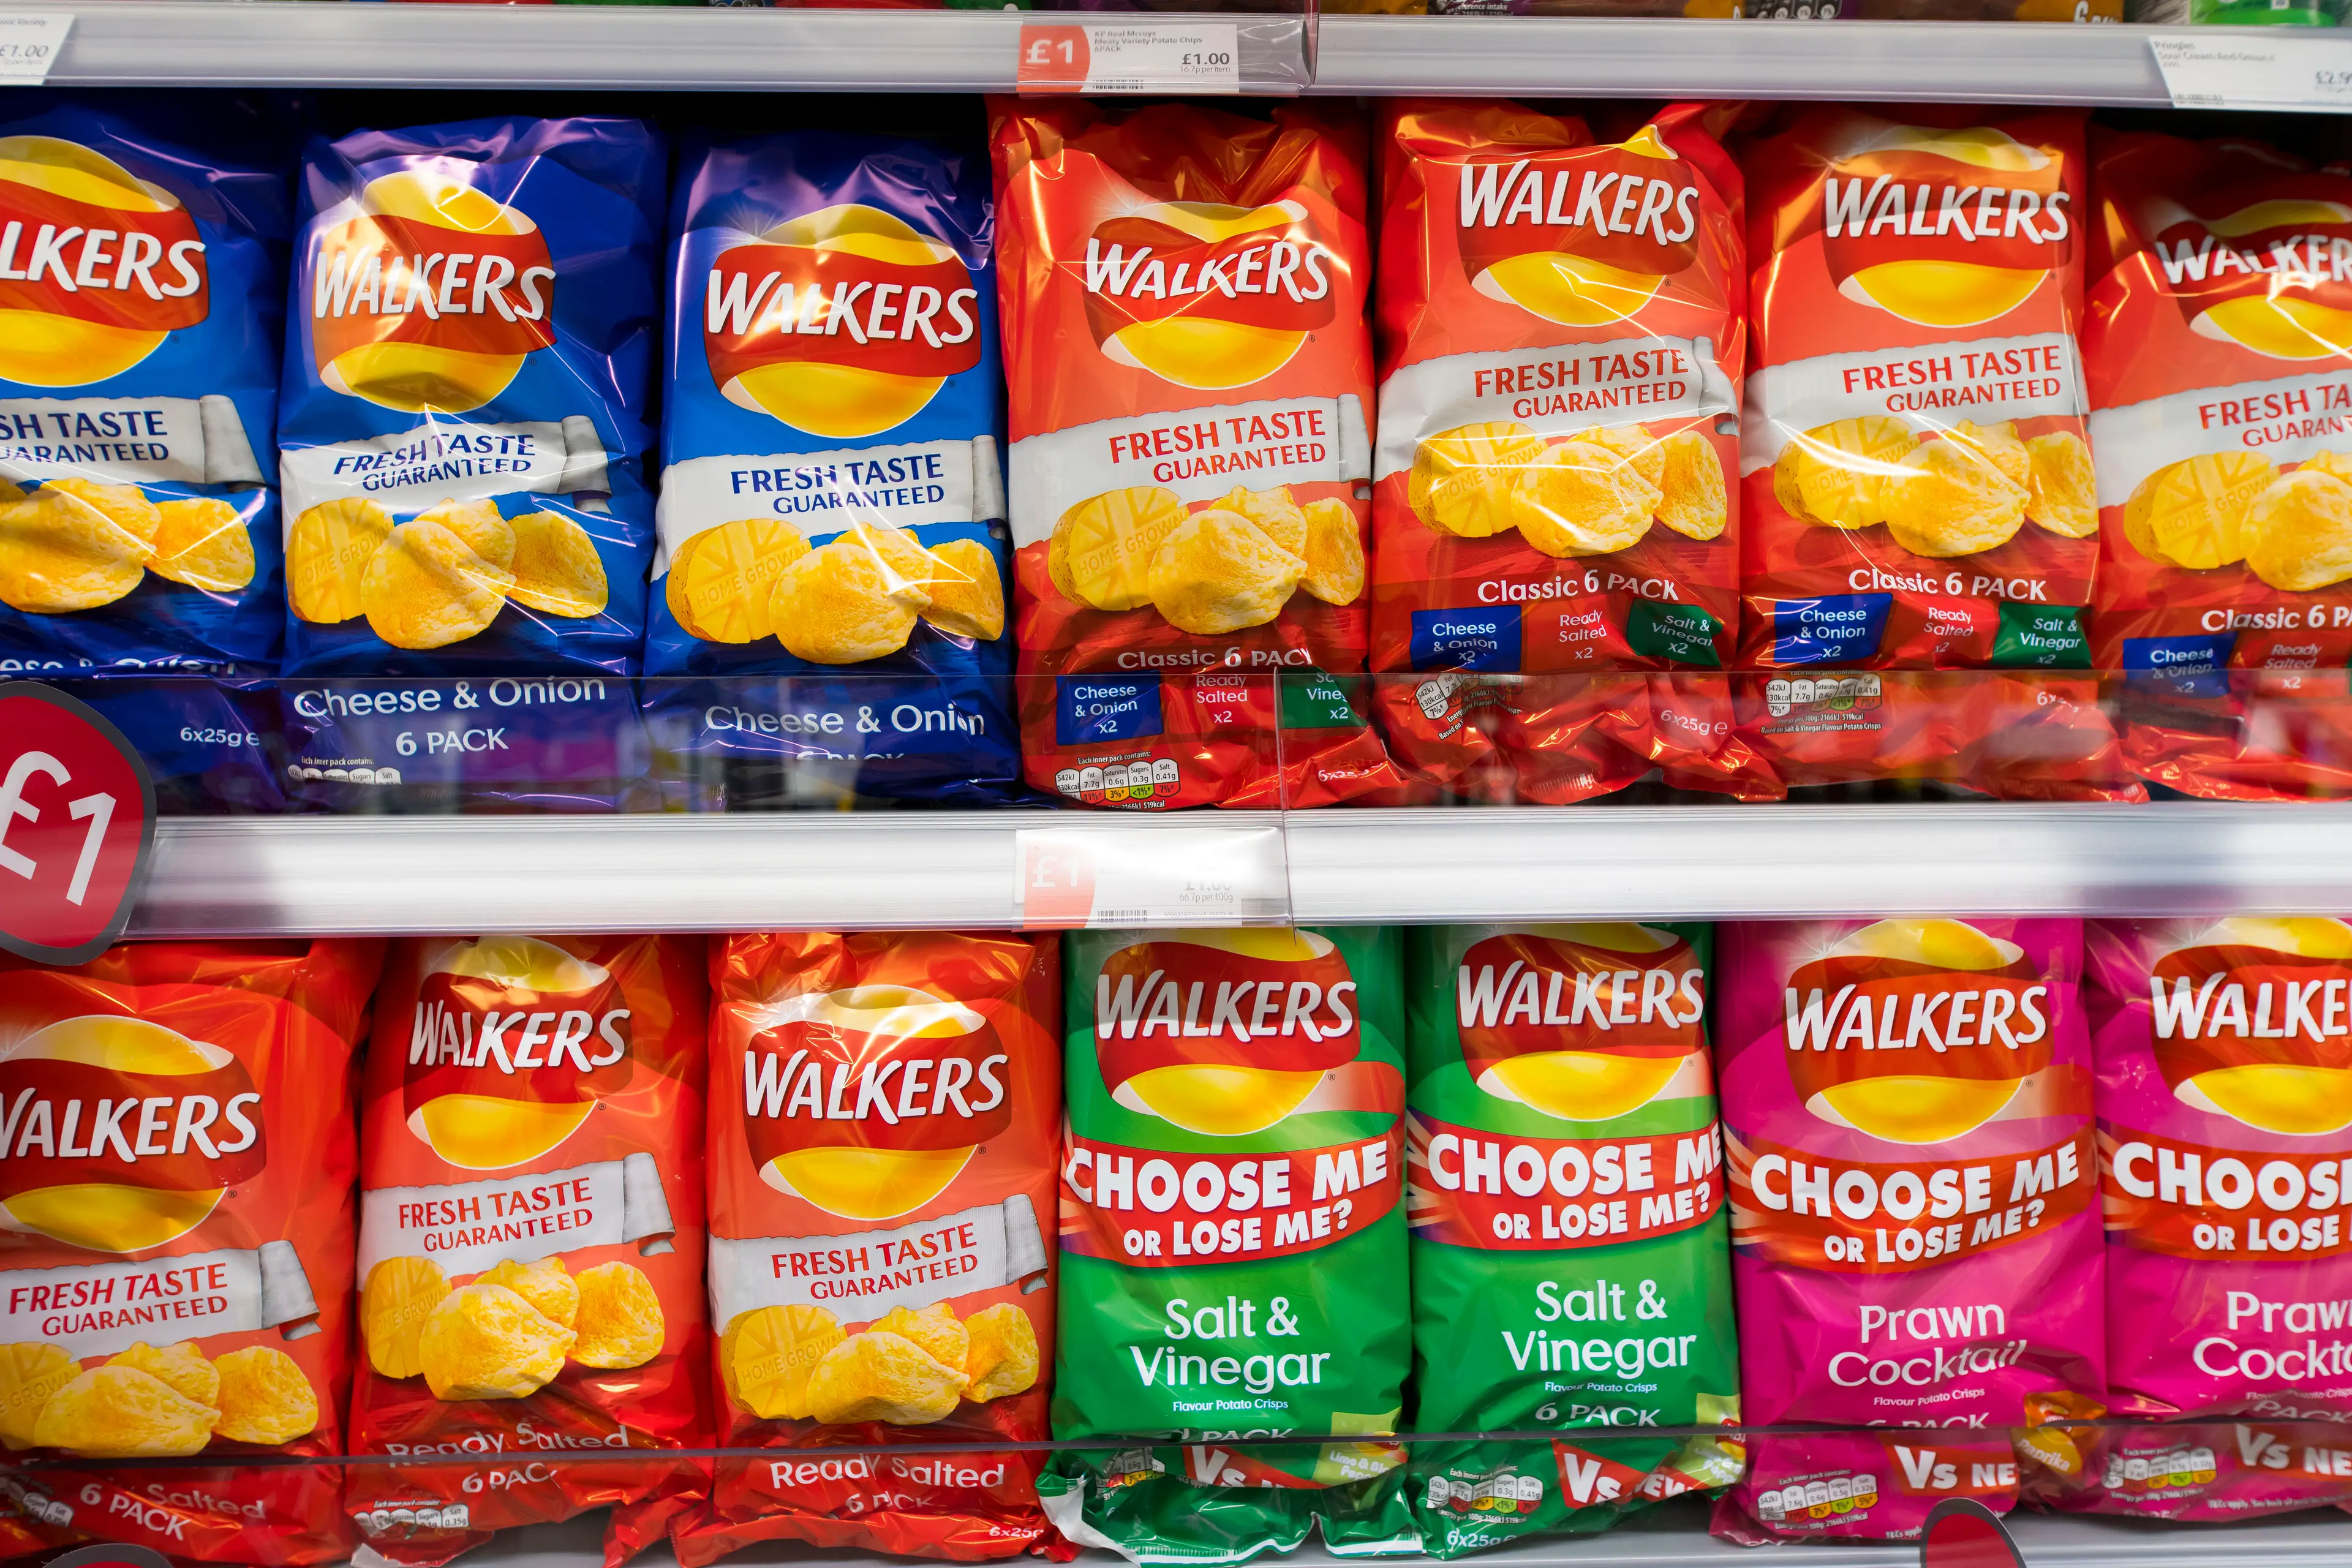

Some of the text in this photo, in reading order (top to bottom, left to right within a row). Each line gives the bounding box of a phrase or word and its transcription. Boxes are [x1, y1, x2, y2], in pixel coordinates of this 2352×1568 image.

[1026, 39, 1073, 64] £1
[1121, 37, 1150, 46] Variety
[1127, 30, 1156, 39] Mccoys
[1182, 53, 1230, 65] £1.00
[1461, 160, 1698, 246] WALKERS
[1825, 174, 2070, 244] WALKERS
[315, 246, 556, 322] WALKERS
[1086, 238, 1329, 303] WALKERS
[708, 270, 977, 349] WALKERS
[1474, 349, 1689, 398] FRESH TASTE
[1842, 345, 2061, 394] FRESH TASTE
[1512, 380, 1686, 419] GUARANTEED
[1886, 378, 2060, 412] GUARANTEED
[1109, 410, 1325, 464] FRESH TASTE
[334, 434, 536, 475] FRESH TASTE
[1153, 443, 1326, 483] GUARANTEED
[362, 459, 532, 491] GUARANTEED
[731, 454, 944, 495] FRESH TASTE
[773, 484, 944, 514] GUARANTEED
[1477, 569, 1679, 603] Classic 6 PACK
[1849, 568, 2046, 601] Classic 6 PACK
[1432, 621, 1496, 637] Cheese
[1559, 609, 1602, 628] Ready
[1664, 615, 1710, 632] Salt &
[1800, 608, 1866, 624] Cheese
[1801, 625, 1866, 639] & Onion
[1923, 622, 1973, 637] Salted
[1928, 607, 1972, 624] Ready
[2033, 617, 2078, 632] Salt &
[2202, 604, 2326, 631] Classic 6
[1433, 638, 1498, 652] & Onion
[1559, 625, 1607, 643] Salted
[2019, 631, 2081, 652] Vinegar
[2036, 654, 2057, 665] x2
[2150, 648, 2214, 663] Cheese
[2266, 658, 2317, 669] Salted
[294, 675, 606, 717] Cheese & Onion
[1074, 684, 1137, 699] Cheese
[1075, 699, 1138, 717] & Onion
[1196, 690, 1248, 704] Salted
[1213, 711, 1233, 723] x2
[396, 727, 509, 756] 6 PACK
[1077, 756, 1092, 765] Each
[1109, 754, 1123, 763] pack
[1125, 751, 1152, 760] contains:
[0, 750, 116, 907] £1
[1031, 856, 1078, 888] £1
[1180, 893, 1200, 903] 66.7p
[1216, 893, 1233, 903] 100g
[1098, 969, 1357, 1042] WALKERS
[1458, 960, 1704, 1030] WALKERS
[1785, 984, 2047, 1053] WALKERS
[409, 999, 631, 1074] WALKERS
[744, 1049, 1008, 1125] WALKERS
[1066, 1140, 1387, 1213] CHOOSE ME
[1751, 1141, 2079, 1221] CHOOSE ME
[399, 1177, 594, 1229] FRESH TASTE
[1493, 1182, 1711, 1239] OR LOSE ME?
[423, 1208, 594, 1253] GUARANTEED
[1123, 1199, 1353, 1256] OR LOSE ME?
[1824, 1198, 2045, 1263] OR LOSE ME?
[2193, 1215, 2340, 1251] OR LOSE
[771, 1222, 978, 1278] FRESH TASTE
[9, 1262, 228, 1314] FRESH TASTE
[810, 1254, 978, 1300] GUARANTEED
[42, 1295, 228, 1336] GUARANTEED
[1164, 1295, 1300, 1340] Salt &
[1535, 1279, 1668, 1322] Salt &
[1859, 1303, 2006, 1343] Prawn
[1129, 1346, 1331, 1394] Vinegar
[1501, 1330, 1697, 1379] Vinegar
[1828, 1339, 2027, 1387] Cocktail
[1545, 1381, 1657, 1393] Flavour Potato Crisps
[1874, 1387, 1985, 1407] Flavour Potato Crisps
[1173, 1398, 1289, 1412] Flavour Potato Crisps
[1535, 1402, 1661, 1428] 6 PACK
[1520, 1490, 1540, 1499] 0.41g
[445, 1518, 466, 1527] 0.35g
